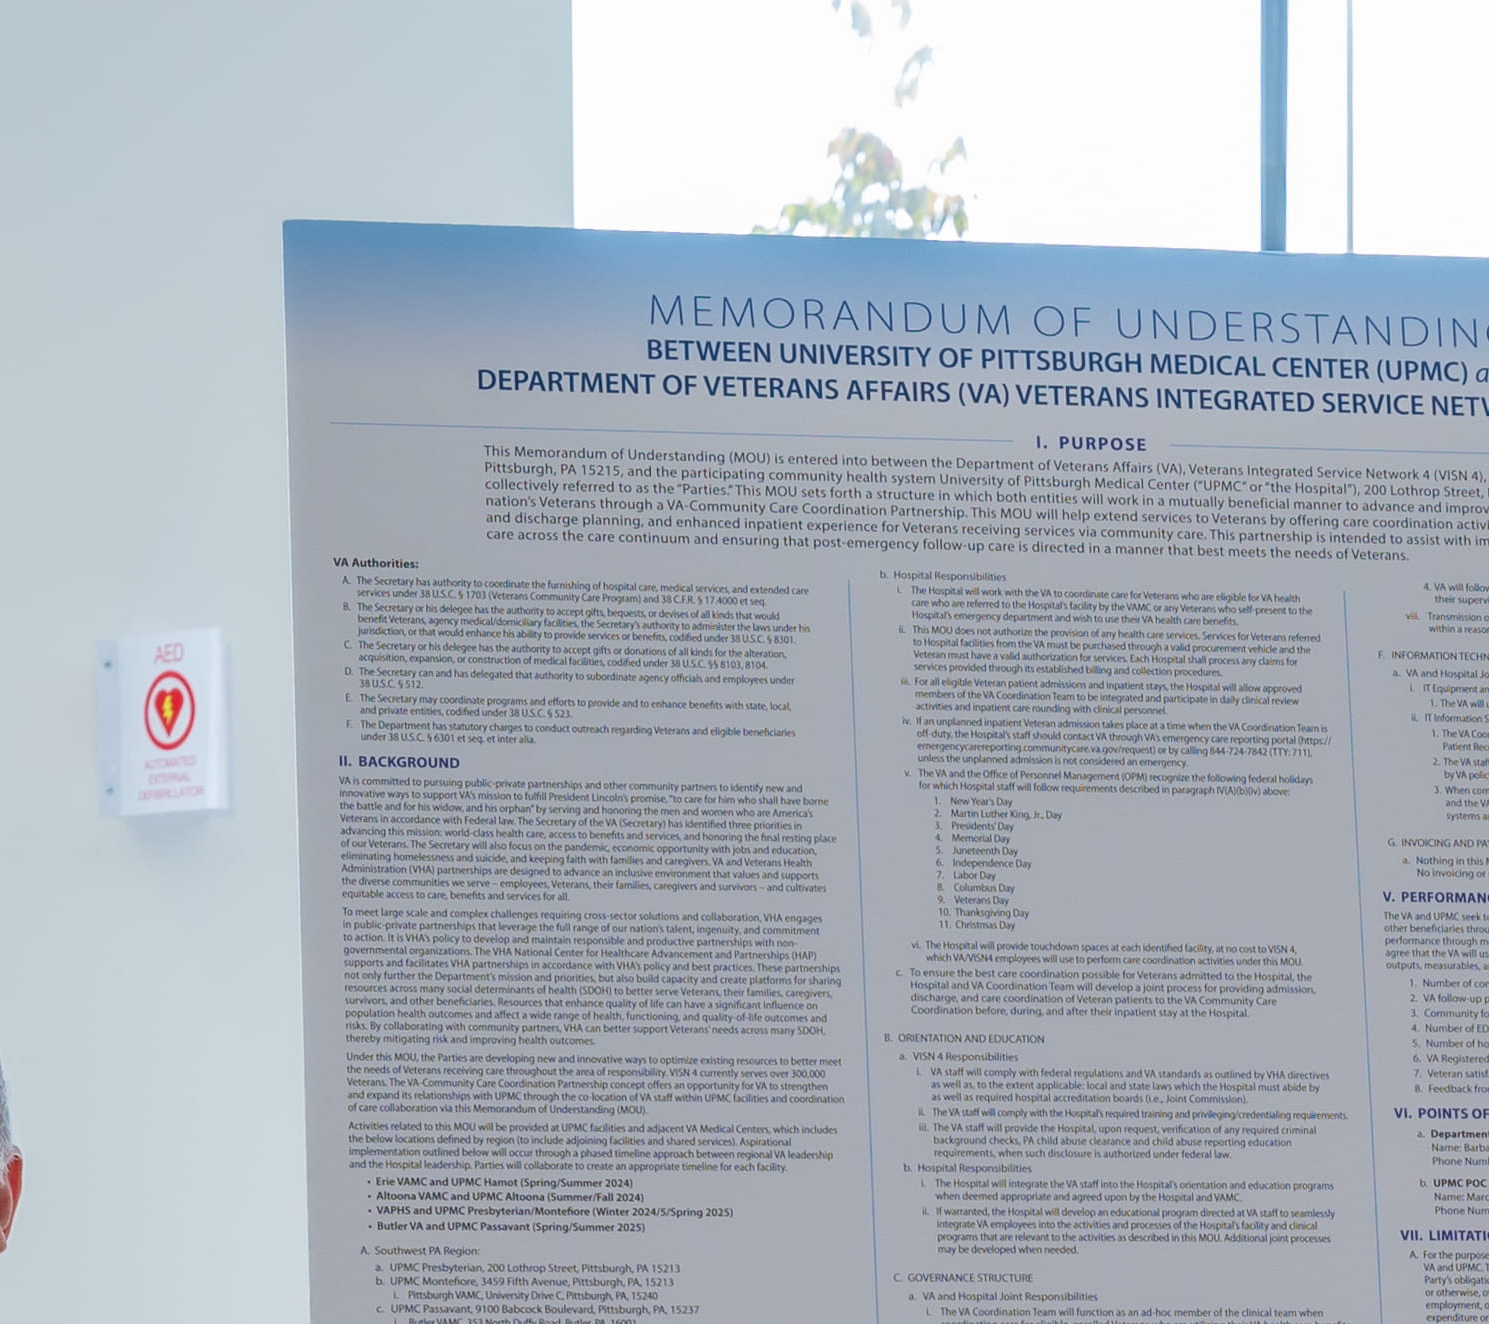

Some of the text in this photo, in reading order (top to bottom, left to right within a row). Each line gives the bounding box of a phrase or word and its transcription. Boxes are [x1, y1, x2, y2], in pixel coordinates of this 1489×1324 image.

[650, 293, 1010, 335] MEMORANDUM
[1033, 305, 1091, 337] OF
[647, 338, 771, 363] BETWEEN
[779, 342, 931, 367] UNIVERSITY
[938, 347, 973, 368] OF
[981, 348, 1142, 373] PITTSBURGH
[1150, 353, 1266, 376] MEDICAL
[1272, 356, 1369, 379] CENTER
[1376, 359, 1468, 386] (UPMC)
[477, 370, 656, 395] DEPARTMENT
[662, 374, 697, 395] OF
[702, 375, 839, 399] VETERANS
[846, 379, 950, 403] AFFAIRS
[958, 381, 1009, 407] (VA)
[1015, 383, 1149, 408] VETERANS
[1156, 387, 1314, 412] INTEGRATED
[1321, 392, 1424, 415] SERVICE
[1036, 435, 1146, 451] I. PURPOSE
[483, 444, 510, 457] This
[514, 445, 607, 459] Memorandum
[610, 447, 625, 460] of
[627, 448, 725, 465] Understanding
[728, 451, 770, 465] (MOU)
[774, 452, 784, 464] is
[787, 453, 838, 465] entered
[841, 454, 867, 466] into
[871, 455, 927, 468] between
[930, 456, 953, 468] the
[956, 456, 1034, 472] Department
[1037, 458, 1051, 471] of
[1053, 459, 1109, 472] Veterans
[1112, 460, 1153, 473] Affairs
[1156, 462, 1185, 476] (VA),
[1188, 463, 1243, 476] Veterans
[1247, 464, 1313, 479] Integrated
[1316, 466, 1362, 479] Service
[1365, 467, 1419, 480] Network
[1422, 469, 1429, 480] 4
[1433, 469, 1467, 482] (VISN
[1471, 470, 1486, 483] 4),
[332, 557, 419, 568] VA Authorities:
[153, 642, 184, 665] AED
[339, 755, 460, 768] II. BACKGROUND
[1382, 890, 1395, 902] V.
[897, 1032, 962, 1043] ORIENTATION
[963, 1033, 987, 1043] AND
[988, 1033, 1045, 1044] EDUCATION
[1393, 1107, 1412, 1119] VI.
[1418, 1107, 1468, 1119] POINTS
[1471, 1107, 1489, 1119] OF
[1433, 1178, 1463, 1187] UPMC
[1465, 1178, 1487, 1188] POC
[1400, 1229, 1423, 1241] VII.
